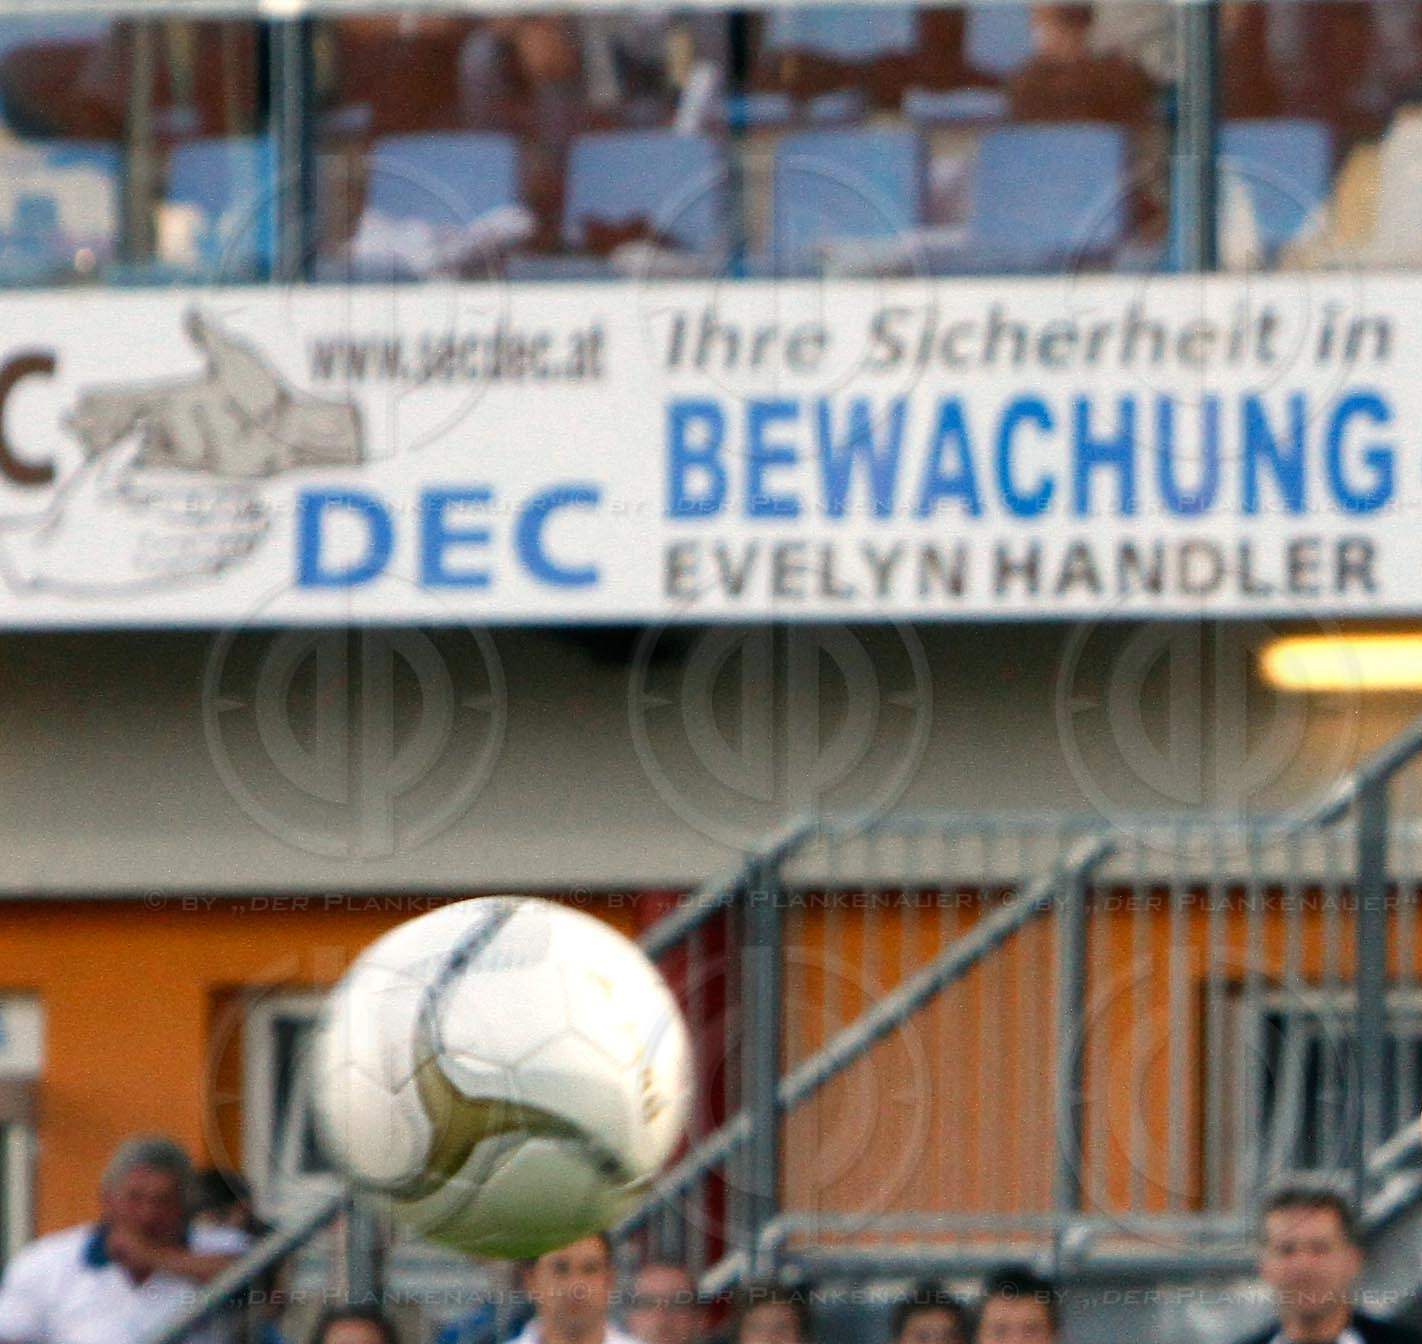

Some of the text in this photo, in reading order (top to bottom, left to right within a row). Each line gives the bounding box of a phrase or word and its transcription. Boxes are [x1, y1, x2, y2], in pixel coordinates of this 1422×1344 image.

[666, 306, 827, 372] Ihre
[868, 302, 1281, 372] Sicherheit
[1315, 300, 1394, 363] in
[665, 390, 1396, 520] BEWACHUNG
[296, 485, 602, 589] DEC
[664, 539, 968, 601] EVELYN
[992, 535, 1381, 598] HANDLER
